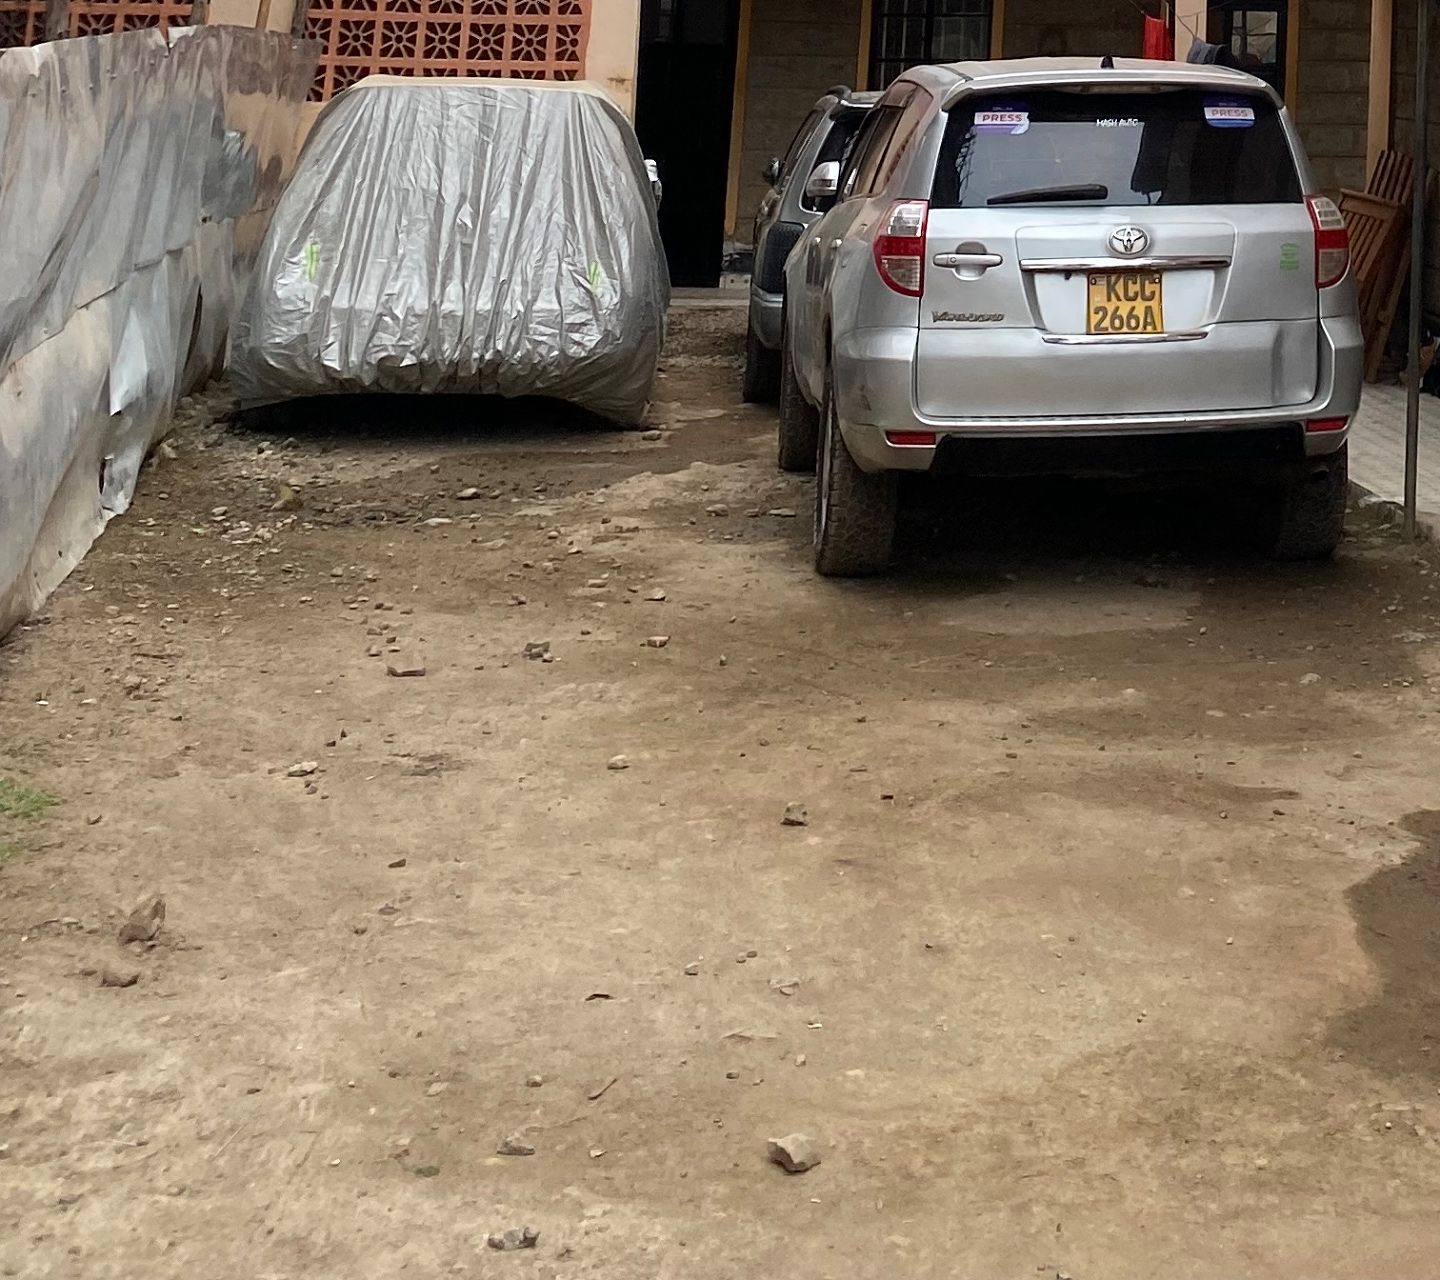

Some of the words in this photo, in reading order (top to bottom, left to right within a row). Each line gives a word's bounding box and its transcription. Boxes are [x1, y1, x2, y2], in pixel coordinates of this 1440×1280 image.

[982, 113, 1023, 122] PRESS
[1211, 108, 1248, 118] PRESS
[1106, 271, 1157, 302] KCC
[1093, 305, 1158, 332] 266A
